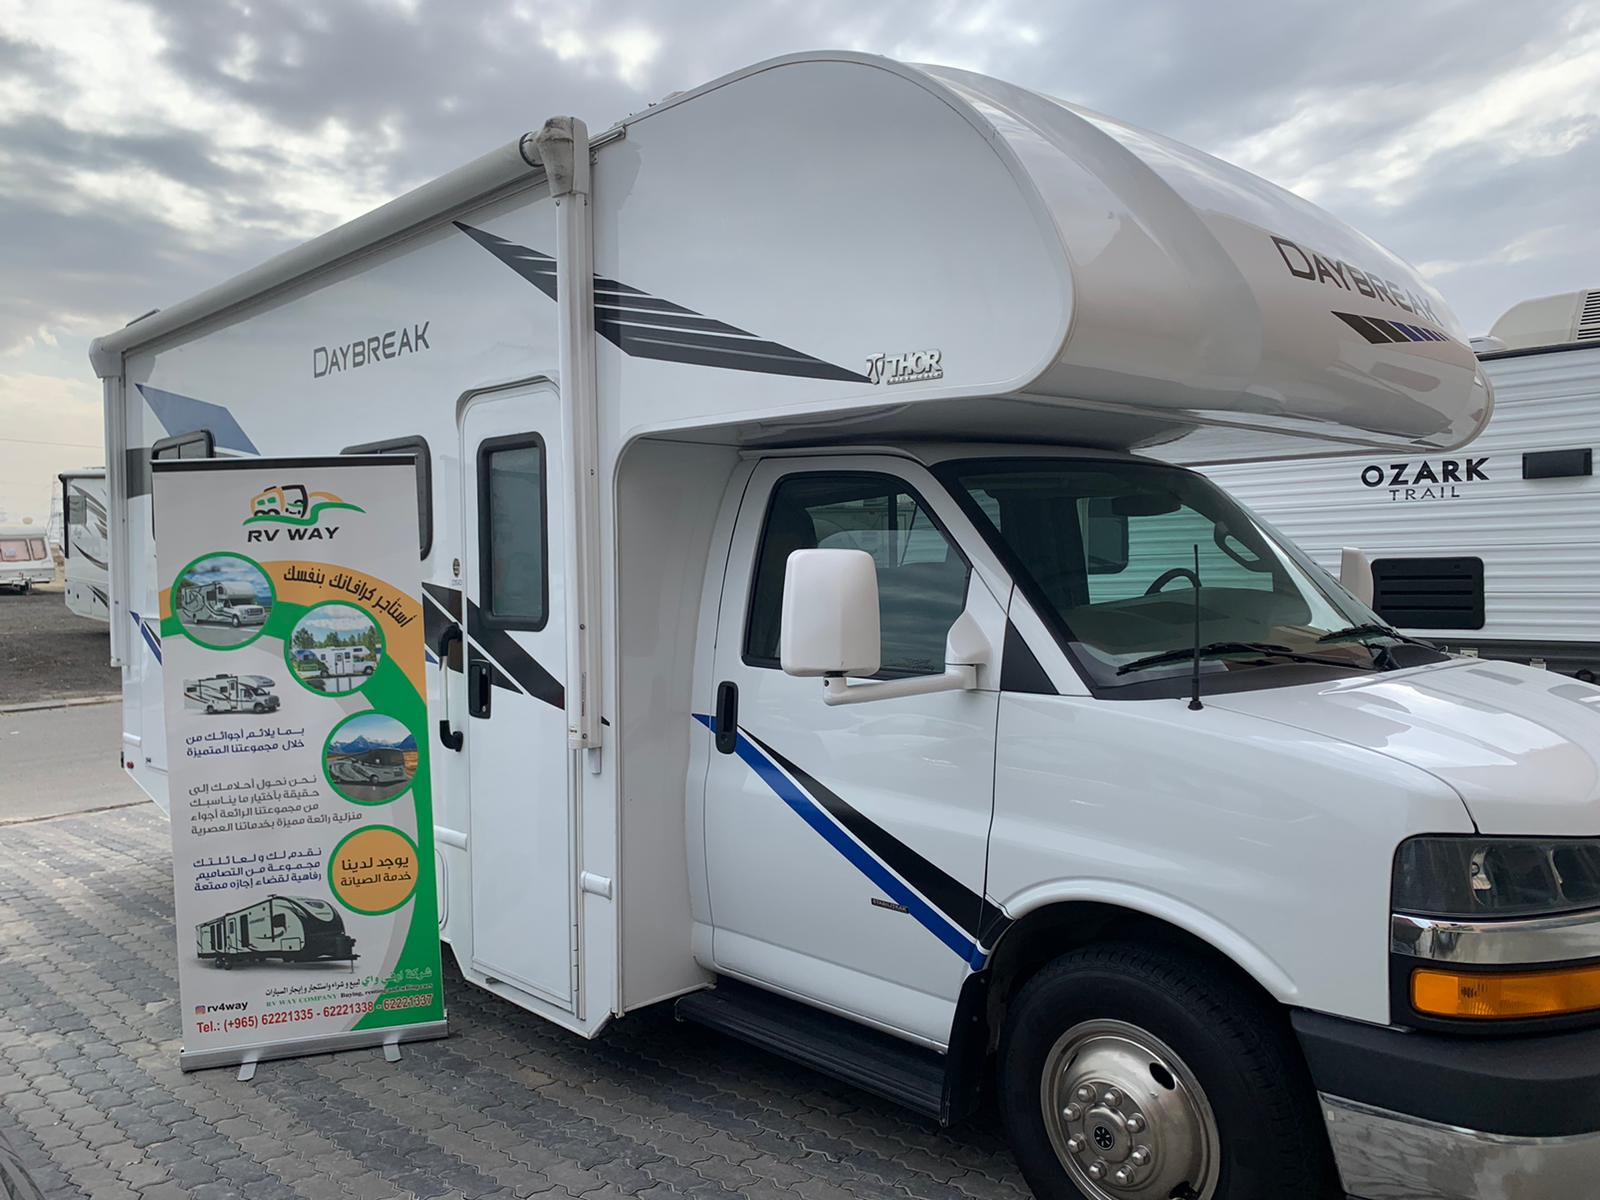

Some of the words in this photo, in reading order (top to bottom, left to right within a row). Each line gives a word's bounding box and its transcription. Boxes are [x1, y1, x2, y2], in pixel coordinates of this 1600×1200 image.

[1270, 235, 1445, 326] DAYBREAK
[313, 320, 430, 378] DAYBREAK
[886, 349, 943, 378] THOR
[1360, 457, 1490, 487] OZARK
[1388, 486, 1460, 501] TRAIL
[247, 528, 280, 542] RV
[287, 526, 340, 541] WAY
[283, 565, 325, 588] بنفسك
[329, 573, 377, 600] كرافانك
[185, 735, 203, 745] من
[282, 739, 304, 751] خلال
[186, 745, 229, 758] المتميزة
[231, 743, 279, 754] مجموعتنا
[238, 794, 249, 803] ما
[219, 807, 253, 820] الرائعة
[254, 805, 302, 816] مجموعتنا
[303, 803, 319, 813] من
[277, 817, 305, 828] مميزة
[306, 814, 331, 825] رائعة
[332, 811, 363, 823] منزلية
[191, 821, 233, 835] العصرية
[235, 819, 275, 831] بخدماتنا
[341, 857, 373, 873] لدينا
[376, 857, 409, 869] يوجد
[195, 867, 243, 881] التصاميم
[255, 874, 289, 886] لقضاء
[291, 872, 322, 883] رفاهية
[340, 873, 381, 887] الصيانة
[383, 871, 412, 882] خدمة
[194, 882, 228, 891] ممتعة
[207, 1001, 249, 1013] rv4way
[223, 1015, 259, 1032] (+965)
[261, 1008, 314, 1025] 62221335
[323, 1001, 374, 1017] 62221338
